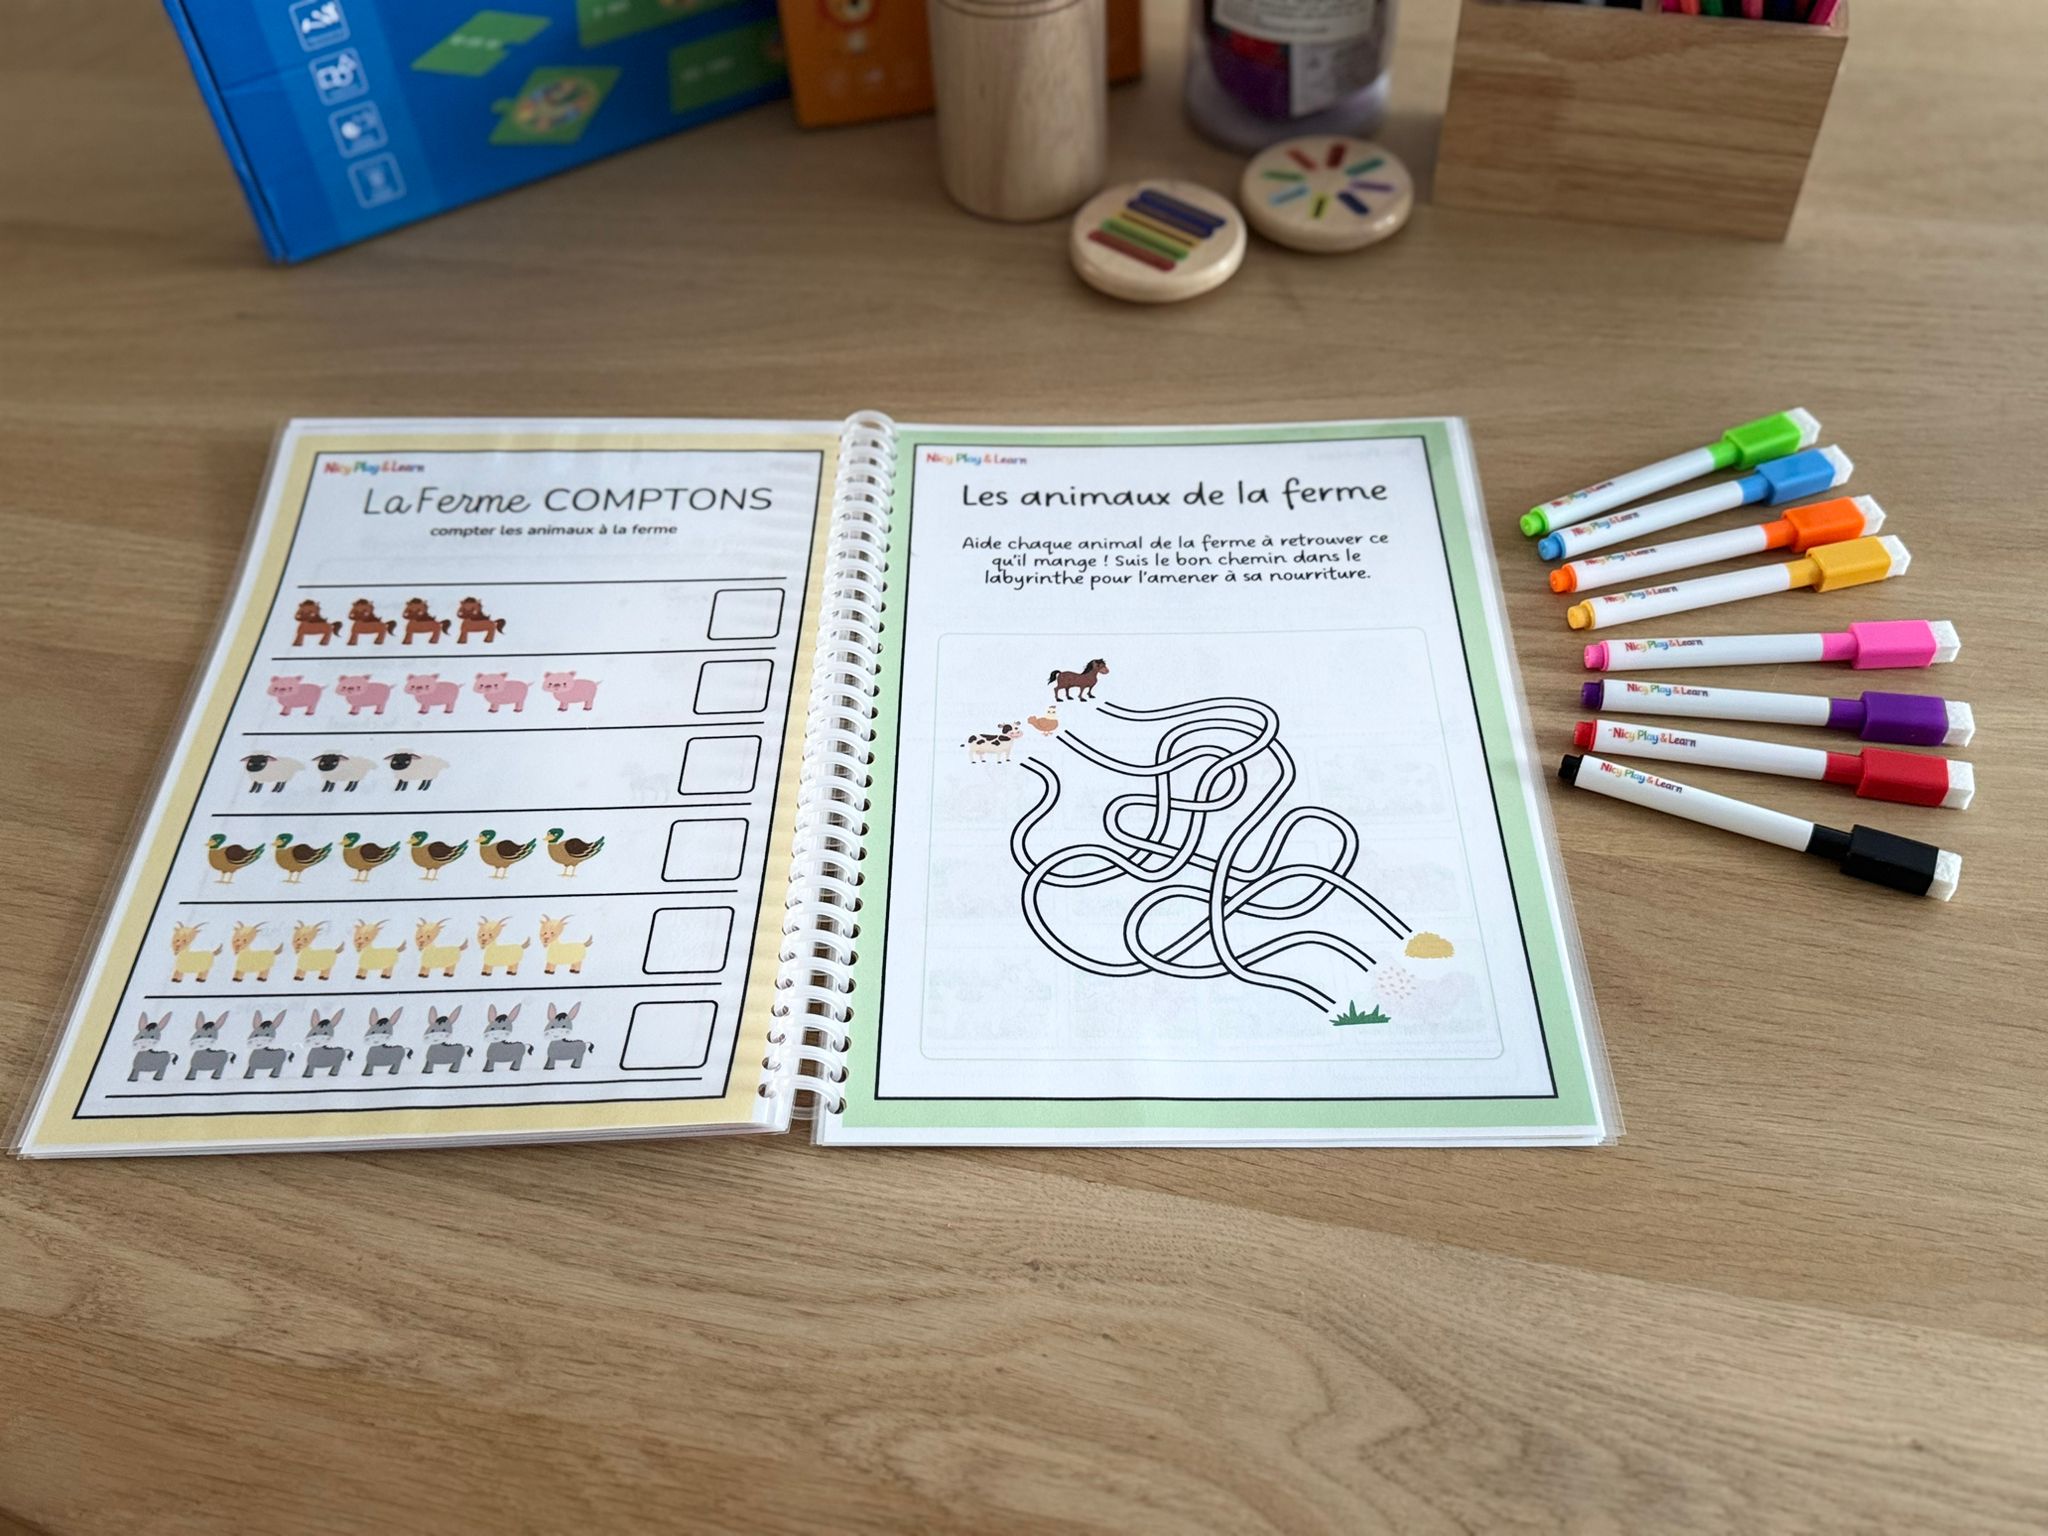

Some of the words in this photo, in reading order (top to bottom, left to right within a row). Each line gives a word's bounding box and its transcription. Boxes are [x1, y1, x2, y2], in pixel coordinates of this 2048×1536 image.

[354, 460, 379, 476] Play
[391, 461, 425, 473] Learn
[956, 452, 982, 466] Play
[994, 454, 1027, 465] Learn
[544, 487, 773, 512] COMPTONS
[962, 484, 1009, 507] Les
[1020, 486, 1170, 507] animaux
[1183, 480, 1224, 506] de
[1238, 480, 1269, 505] la
[1282, 476, 1388, 511] ferme
[430, 525, 496, 538] compter
[501, 524, 523, 536] les
[527, 524, 594, 536] animaux
[598, 523, 608, 535] à
[613, 523, 627, 535] la
[632, 523, 678, 535] ferme
[962, 535, 1002, 550] Aide
[1007, 536, 1073, 555] chaque
[1078, 535, 1143, 550] animal
[1150, 535, 1172, 550] de
[1178, 535, 1195, 549] la
[1202, 534, 1256, 552] ferme
[1261, 534, 1274, 547] à
[1280, 533, 1364, 547] retrouver
[1369, 533, 1389, 545] ce
[991, 553, 1027, 573] qu'il
[1033, 555, 1097, 573] mange
[1102, 554, 1109, 567] !
[1115, 554, 1149, 567] Suis
[1155, 553, 1170, 567] le
[1176, 551, 1212, 566] bon
[1218, 550, 1287, 566] chemin
[1293, 550, 1340, 564] dans
[1345, 548, 1361, 562] le
[984, 569, 1085, 591] labyrinthe
[1090, 573, 1133, 591] pour
[1138, 569, 1219, 585] l'amener
[1224, 569, 1237, 583] à
[1243, 571, 1263, 583] sa
[1269, 567, 1371, 582] nourriture.
[1647, 640, 1669, 651] Play
[1676, 639, 1704, 647] Learn
[1626, 683, 1649, 695] Nicy
[1650, 684, 1672, 696] Play
[1681, 686, 1709, 697] Learn
[1613, 727, 1635, 743] Nicy
[1637, 729, 1659, 745] Play
[1660, 732, 1668, 743] &
[1668, 733, 1697, 747] Learn
[1600, 762, 1622, 777] Nicy
[1624, 769, 1646, 784] Play
[1646, 776, 1654, 784] &
[1654, 778, 1683, 793] Learn
